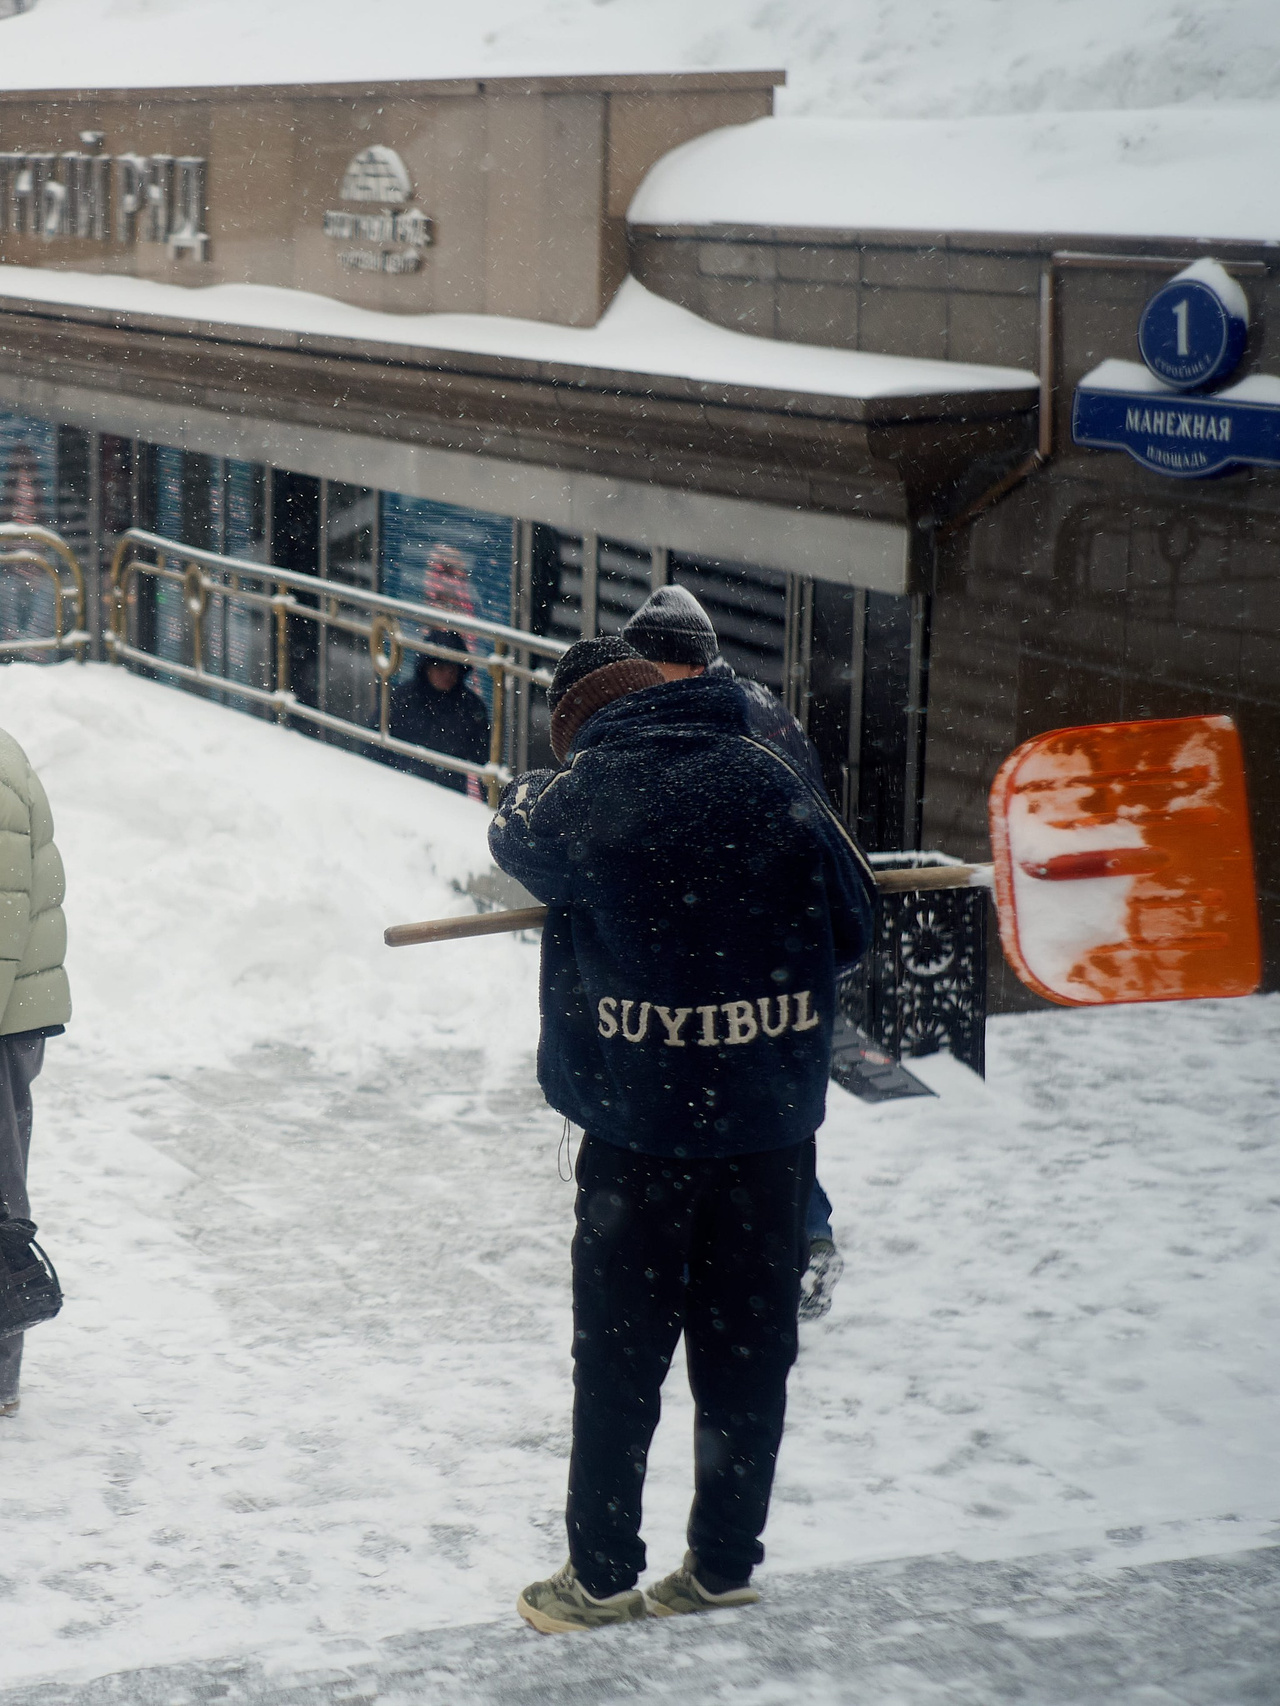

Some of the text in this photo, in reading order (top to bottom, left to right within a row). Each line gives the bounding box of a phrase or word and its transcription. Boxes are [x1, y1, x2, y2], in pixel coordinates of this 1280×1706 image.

[1171, 299, 1189, 356] 1
[1125, 407, 1231, 441] МАНЕЖНАЯ
[1146, 444, 1207, 468] ПЛОЩАДЬ
[597, 990, 819, 1047] SUYIBUL
